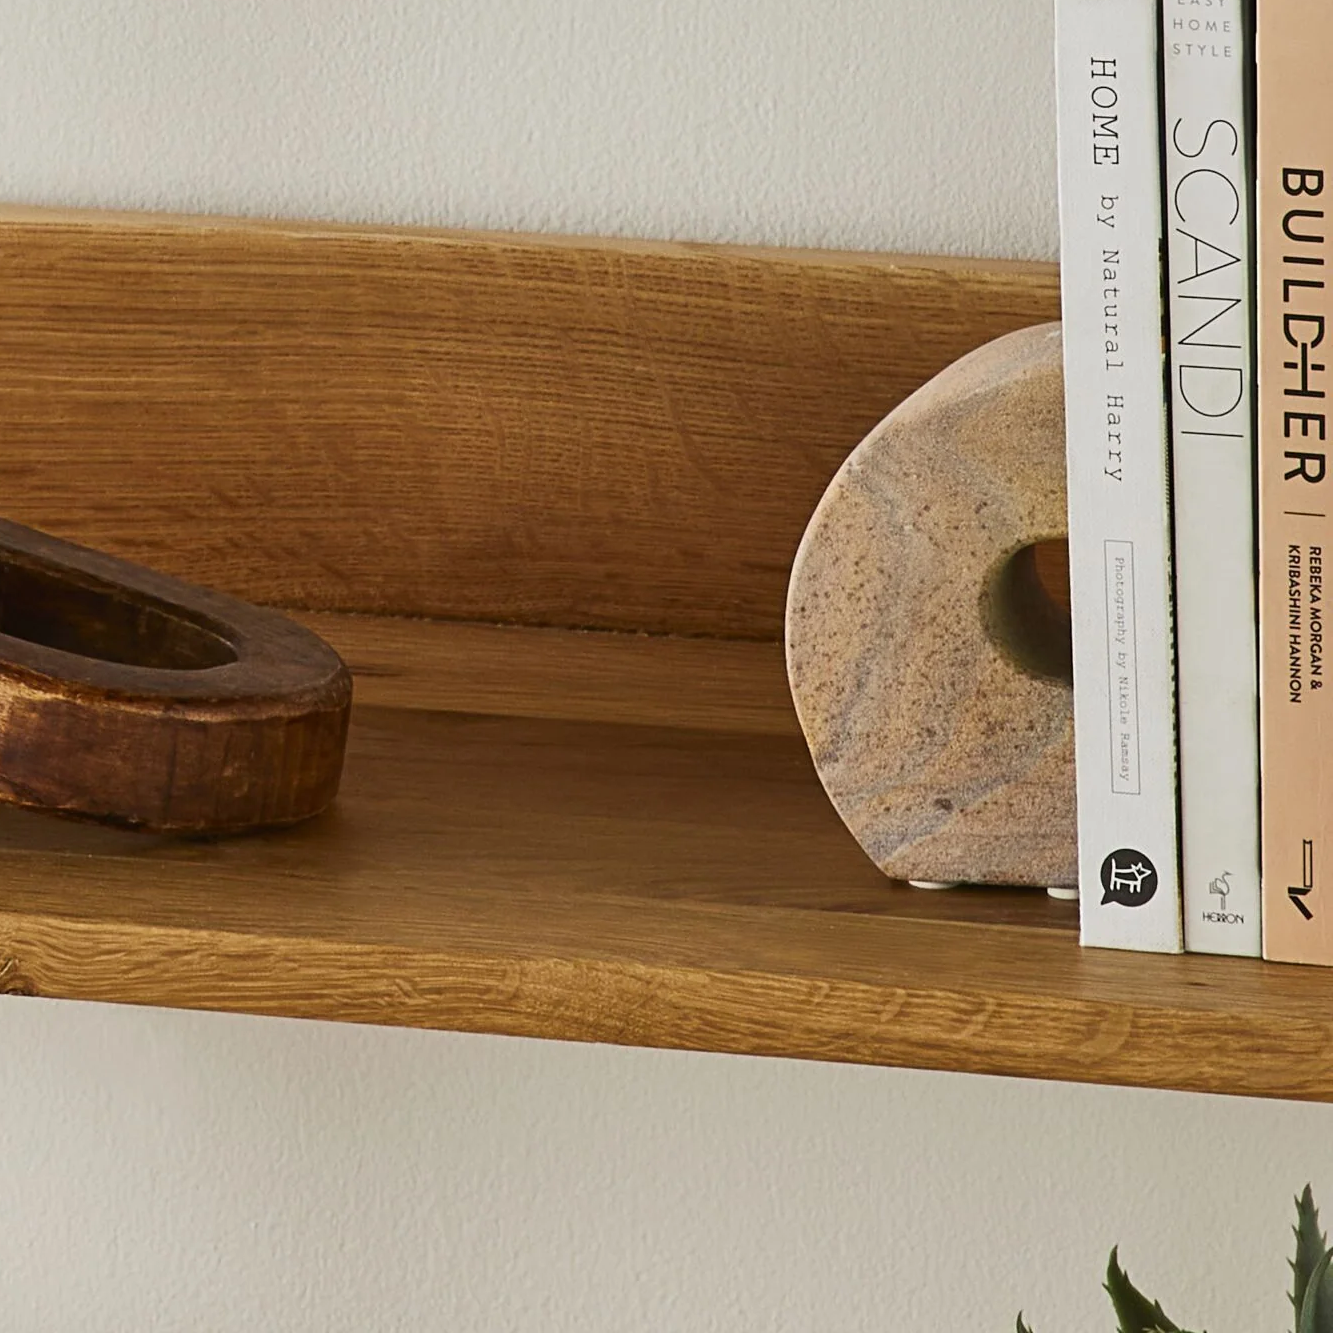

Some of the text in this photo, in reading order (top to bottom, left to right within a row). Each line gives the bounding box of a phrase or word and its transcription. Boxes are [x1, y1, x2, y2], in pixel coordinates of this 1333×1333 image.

[1172, 17, 1232, 33] HOME
[1172, 42, 1233, 59] STYLE
[1090, 56, 1125, 483] HOME by Natural Harry
[1173, 118, 1244, 438] SCANDI
[1114, 556, 1131, 782] Photography by Nikole Ramsay
[1288, 544, 1302, 704] KRIBASHINI HANNON
[1309, 546, 1323, 690] REBEKA MORGAN &
